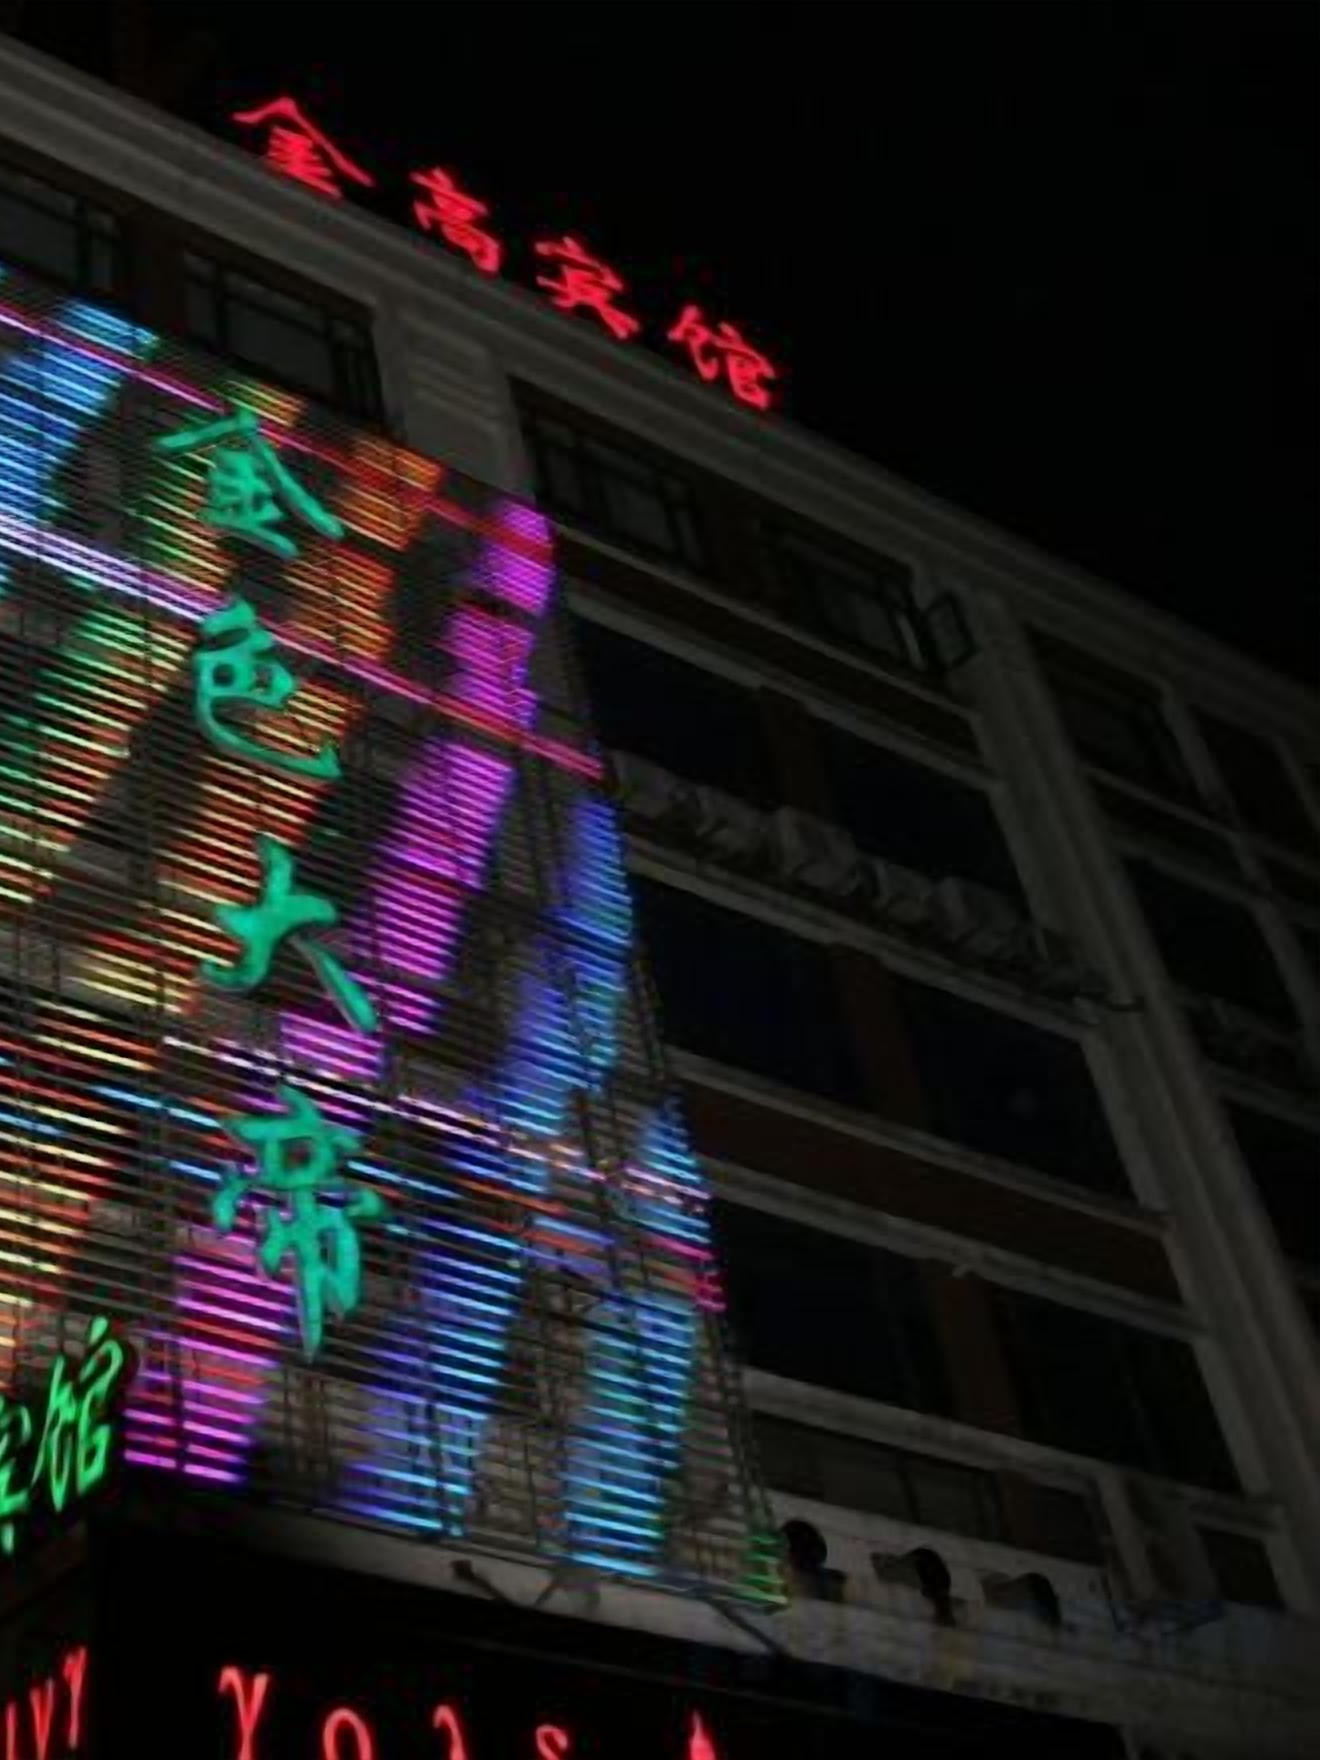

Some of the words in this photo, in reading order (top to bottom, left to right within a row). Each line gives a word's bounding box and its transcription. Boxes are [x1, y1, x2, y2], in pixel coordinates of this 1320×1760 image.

[234, 96, 777, 411] 金高宾馆
[160, 403, 386, 1355] 金色大帝
